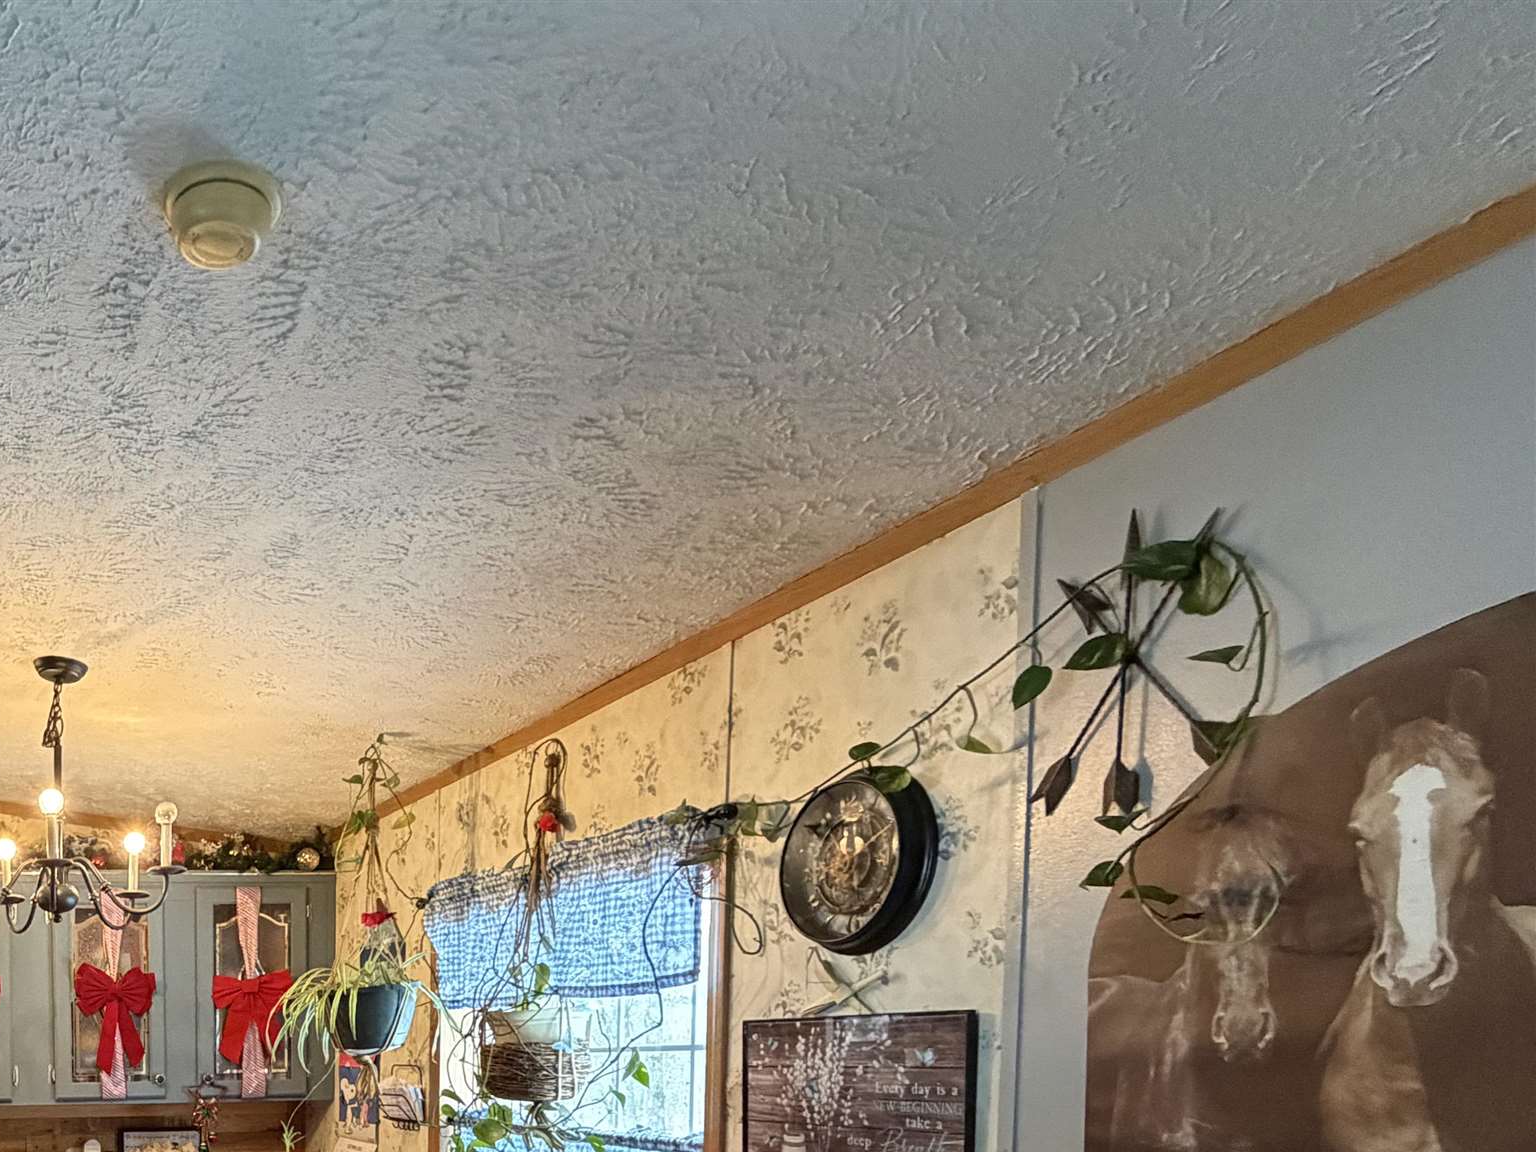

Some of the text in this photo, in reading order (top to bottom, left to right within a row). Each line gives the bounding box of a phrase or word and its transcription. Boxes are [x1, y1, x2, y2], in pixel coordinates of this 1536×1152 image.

[875, 1081, 959, 1098] Every day is a
[899, 1101, 963, 1115] BEGINNING
[905, 1116, 943, 1130] take a
[847, 1135, 872, 1151] deep
